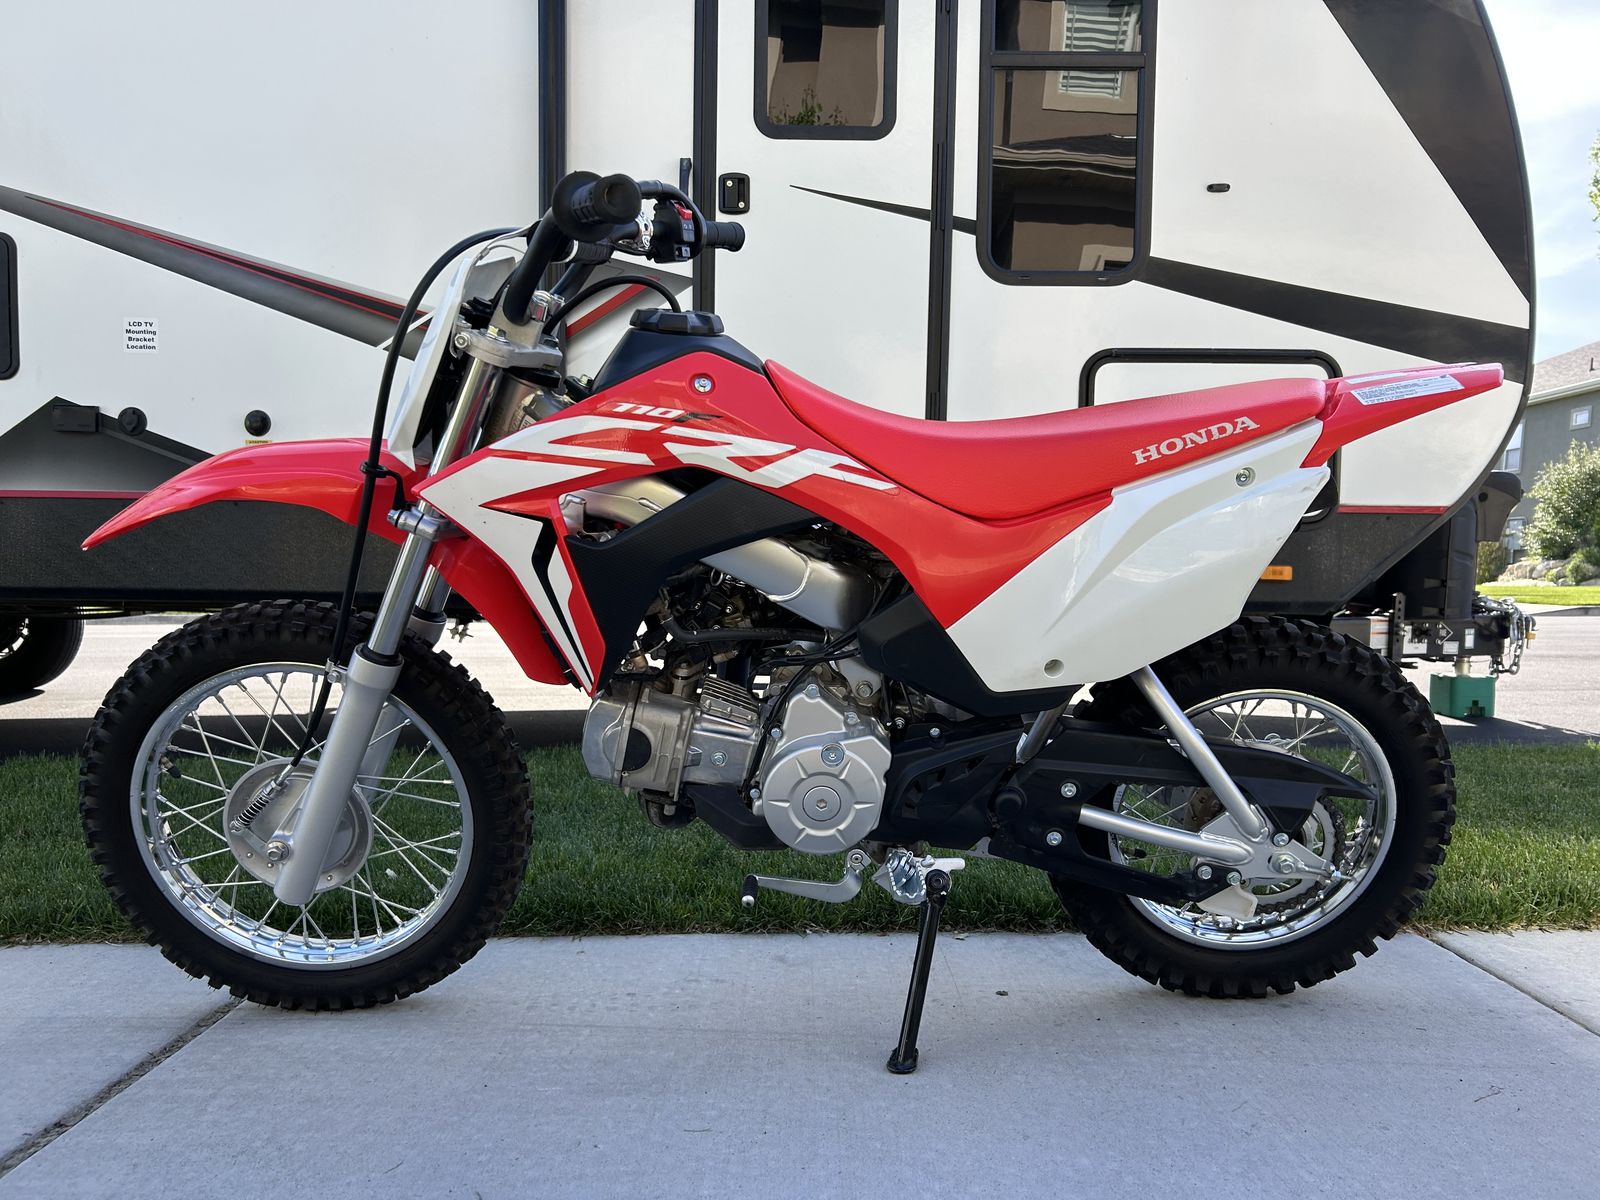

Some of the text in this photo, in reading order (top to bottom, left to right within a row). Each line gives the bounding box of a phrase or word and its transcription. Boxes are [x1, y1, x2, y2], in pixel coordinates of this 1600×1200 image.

[125, 328, 156, 336] Mounting
[488, 415, 900, 490] CRF
[1131, 416, 1260, 466] HONDA
